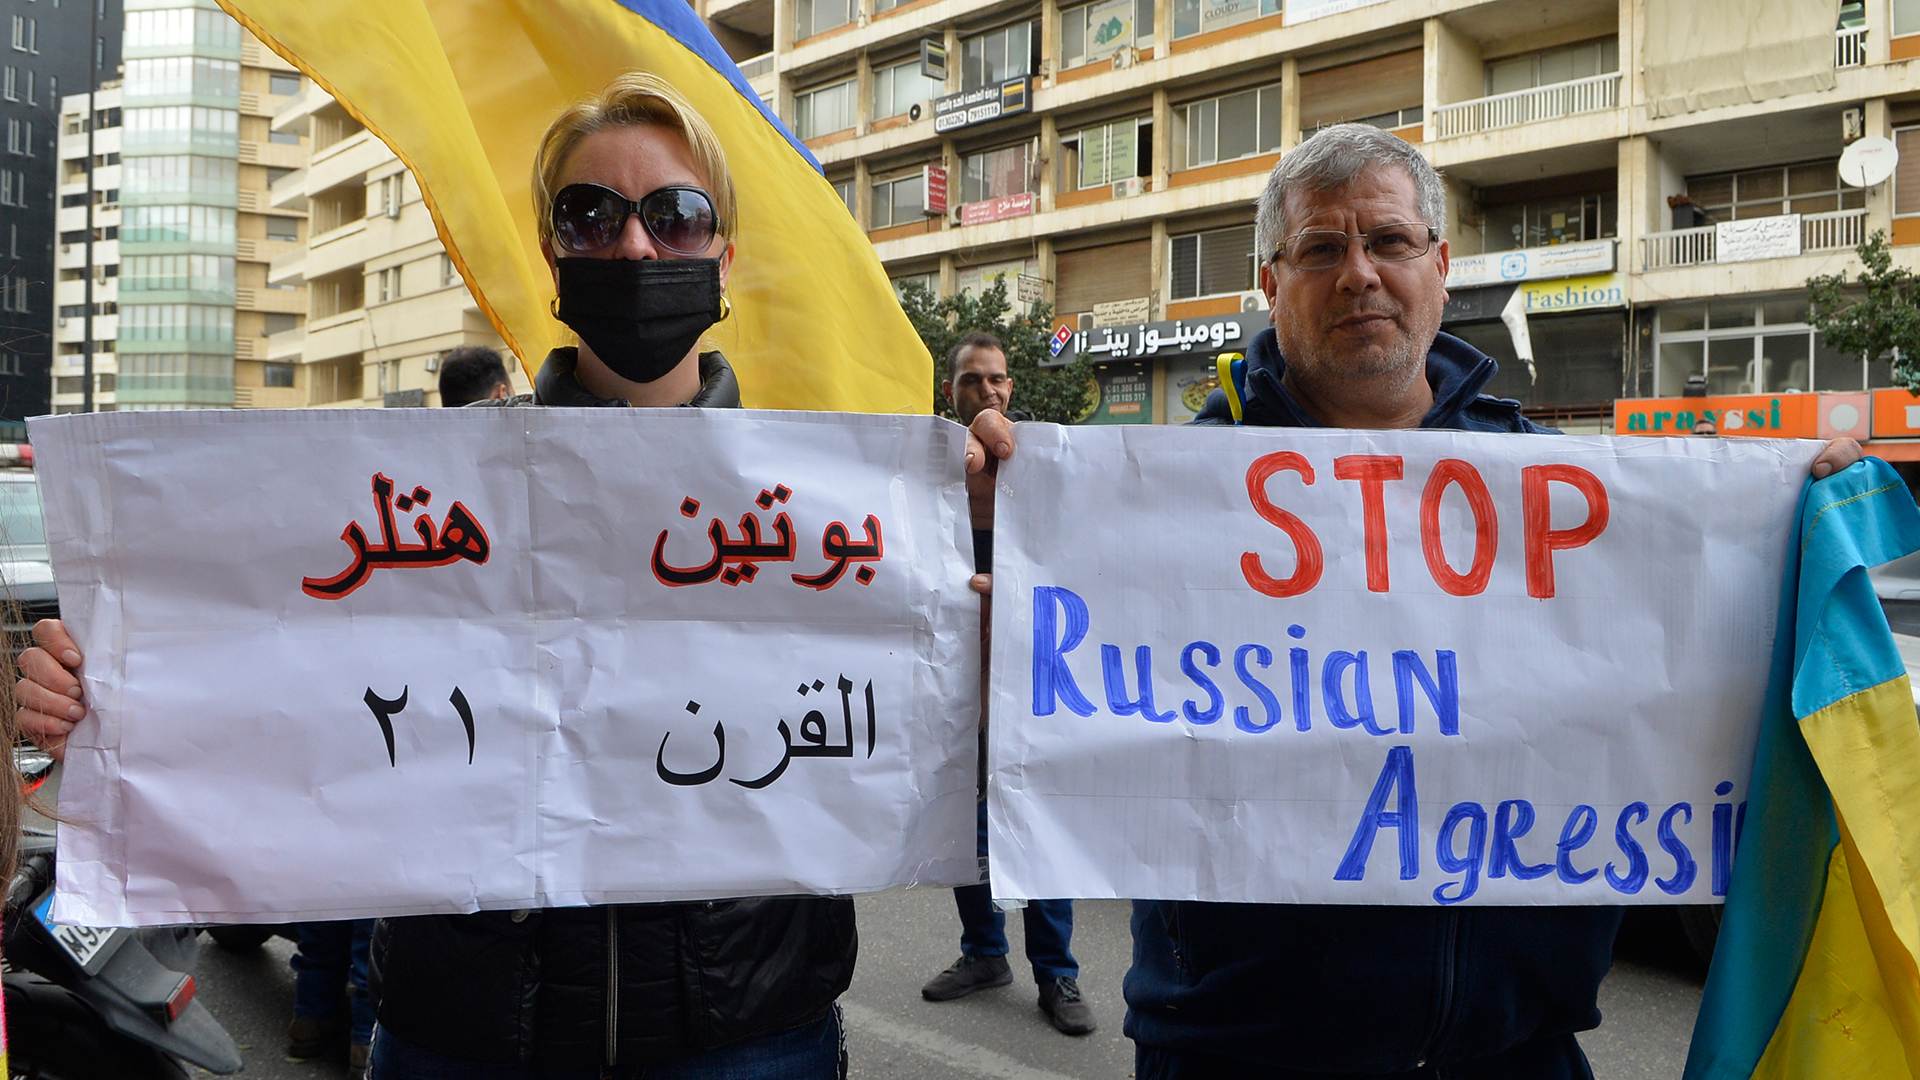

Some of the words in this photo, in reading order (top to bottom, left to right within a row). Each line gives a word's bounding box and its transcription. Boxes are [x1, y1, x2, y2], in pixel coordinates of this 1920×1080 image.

[1204, 3, 1240, 19] CLOUDY
[970, 105, 999, 120] 79151116
[1526, 285, 1622, 309] Fashion
[1074, 328, 1130, 357] بيتزا
[1136, 320, 1241, 356] دومينوز
[302, 472, 490, 600] هتلر
[651, 483, 883, 591] بوتين
[1240, 450, 1610, 600] STOP
[363, 684, 475, 768] ٢١
[656, 674, 875, 790] القرن
